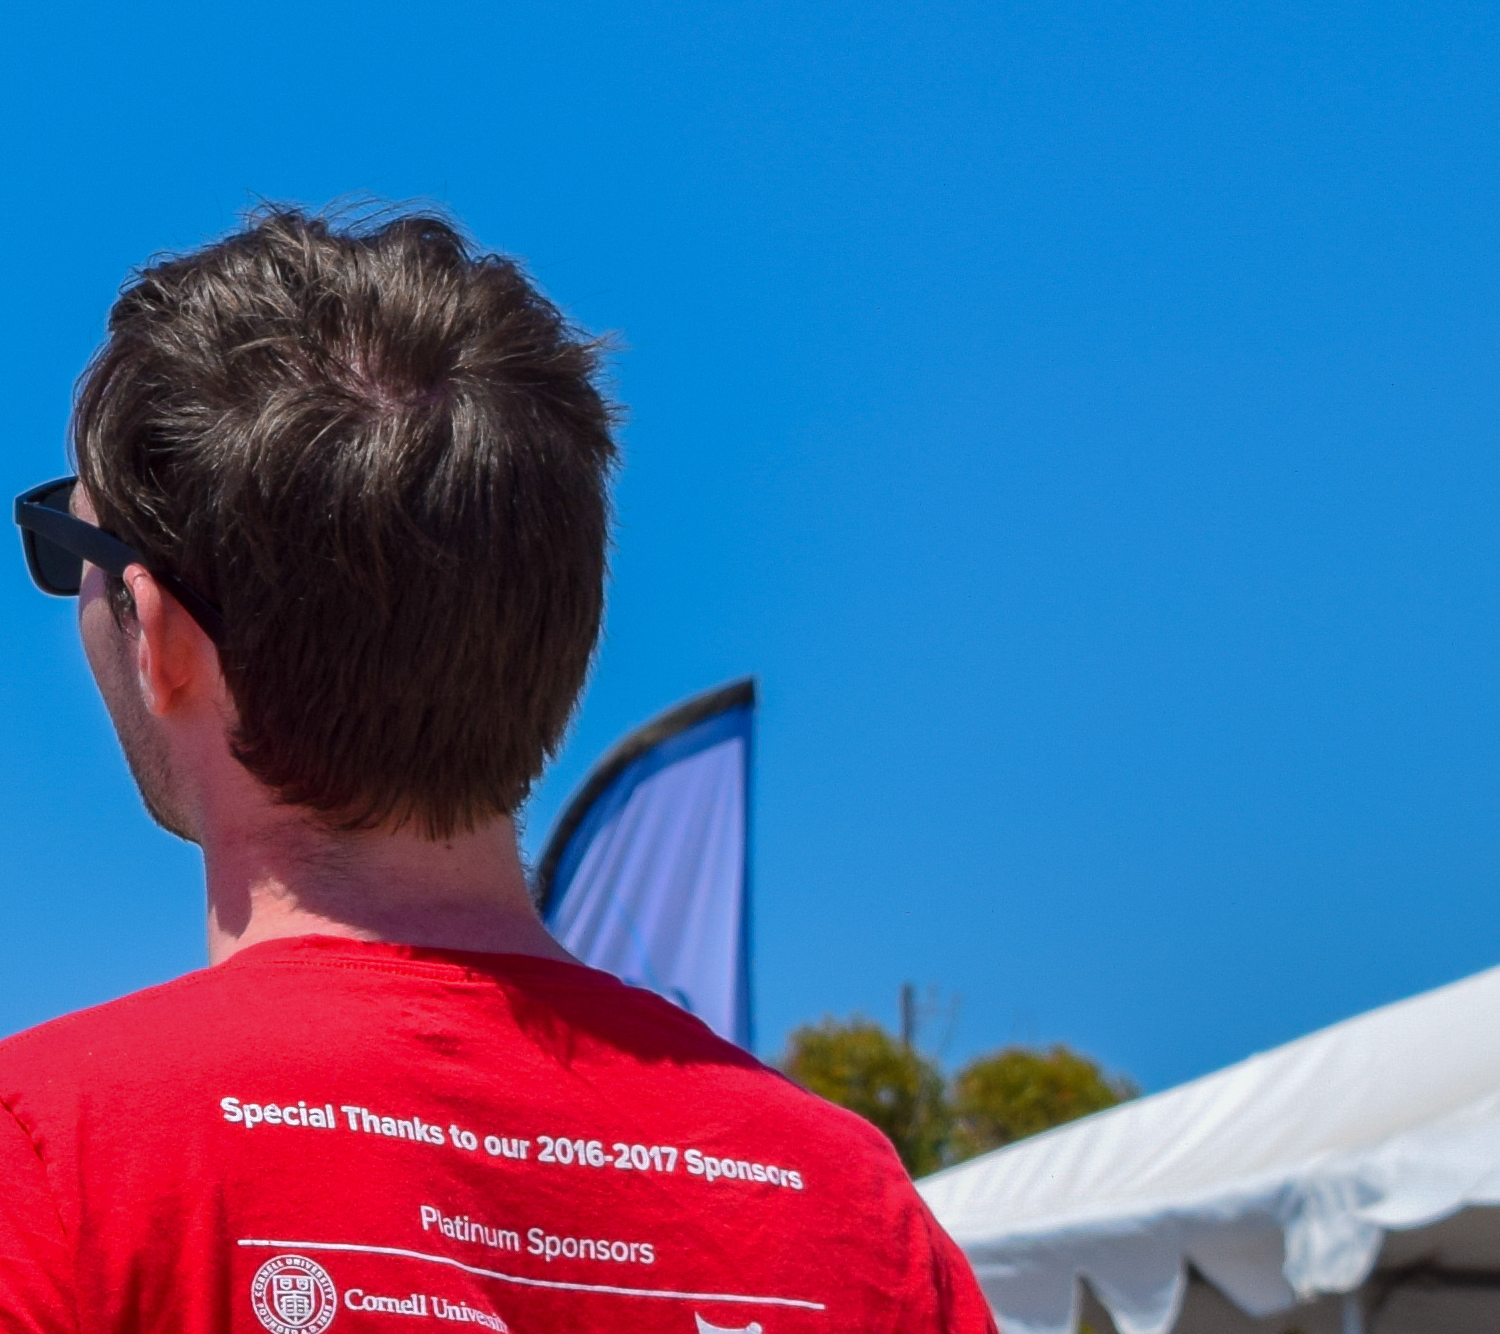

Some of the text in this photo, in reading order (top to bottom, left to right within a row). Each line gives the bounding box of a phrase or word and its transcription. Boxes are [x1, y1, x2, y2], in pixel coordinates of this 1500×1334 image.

[220, 1096, 804, 1190] Special Thanks to our 2016-2017 Sponsors
[419, 1204, 655, 1265] Platinum Sponsors
[344, 1288, 428, 1316] Cornell
